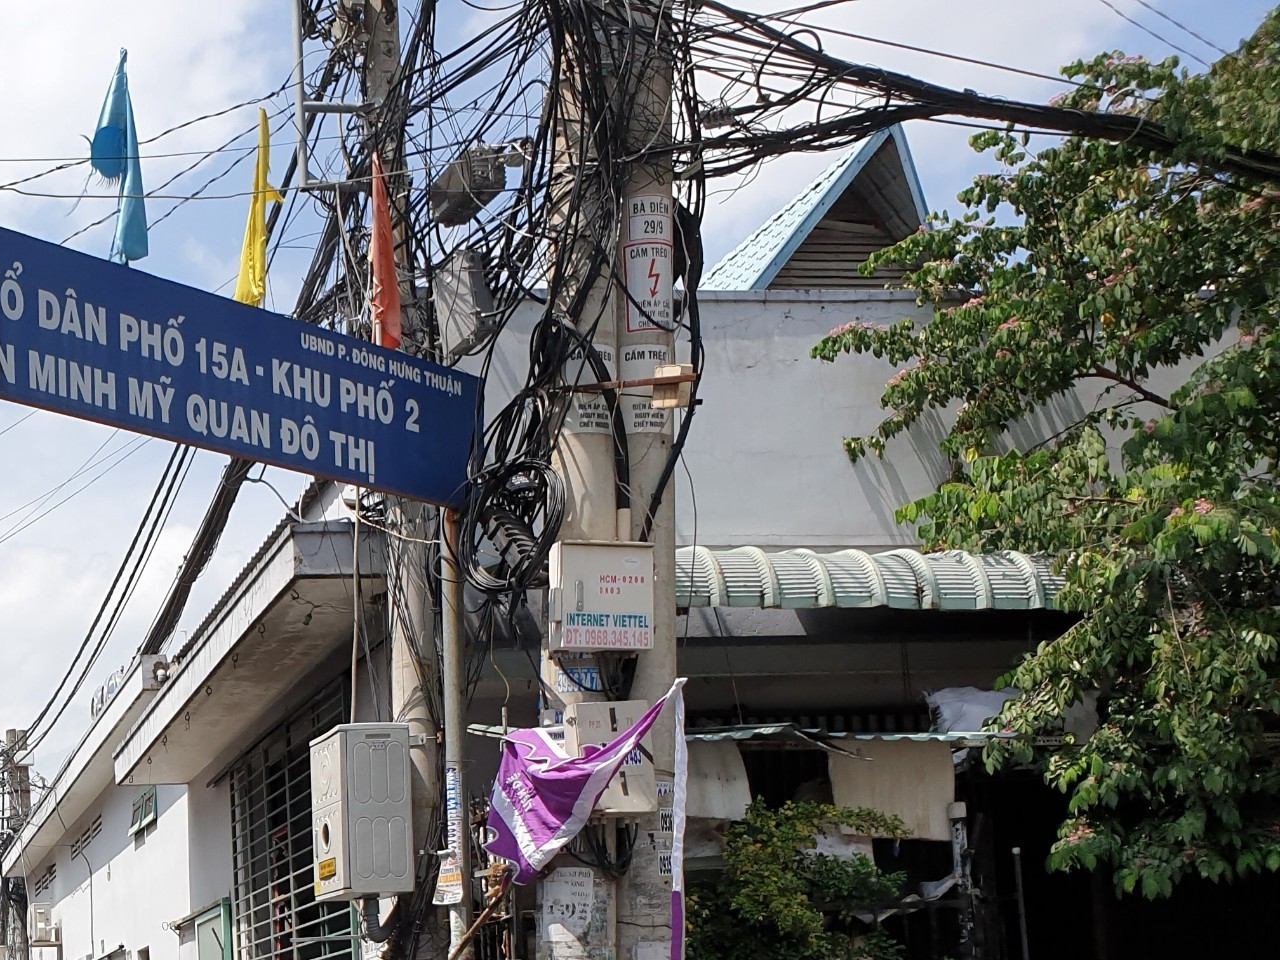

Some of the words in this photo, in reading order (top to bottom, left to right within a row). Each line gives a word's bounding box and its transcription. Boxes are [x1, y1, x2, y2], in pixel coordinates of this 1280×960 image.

[632, 200, 647, 215] BÀ
[644, 219, 664, 235] 29/9
[630, 246, 648, 259] CẤM
[650, 246, 668, 260] TRÈO
[38, 288, 108, 346] DÂN
[120, 313, 186, 367] PHỐ
[195, 337, 250, 386] 15A
[272, 358, 331, 408] KHU
[340, 377, 396, 425] PHỐ
[405, 398, 420, 433] 2
[625, 348, 645, 361] CẤM
[301, 332, 335, 357] UBND
[352, 346, 386, 373] ĐÔNG
[389, 357, 422, 383] HƯNG
[424, 370, 463, 398] THUẬN
[28, 349, 117, 411] MINH
[128, 376, 175, 424] MỸ
[186, 393, 271, 450] QUAN
[280, 415, 320, 461] ĐÔ
[329, 430, 376, 484] THỊ
[566, 612, 610, 627] INTERNET
[613, 614, 649, 628] VIETTEL
[585, 629, 649, 647] 0968.345.145
